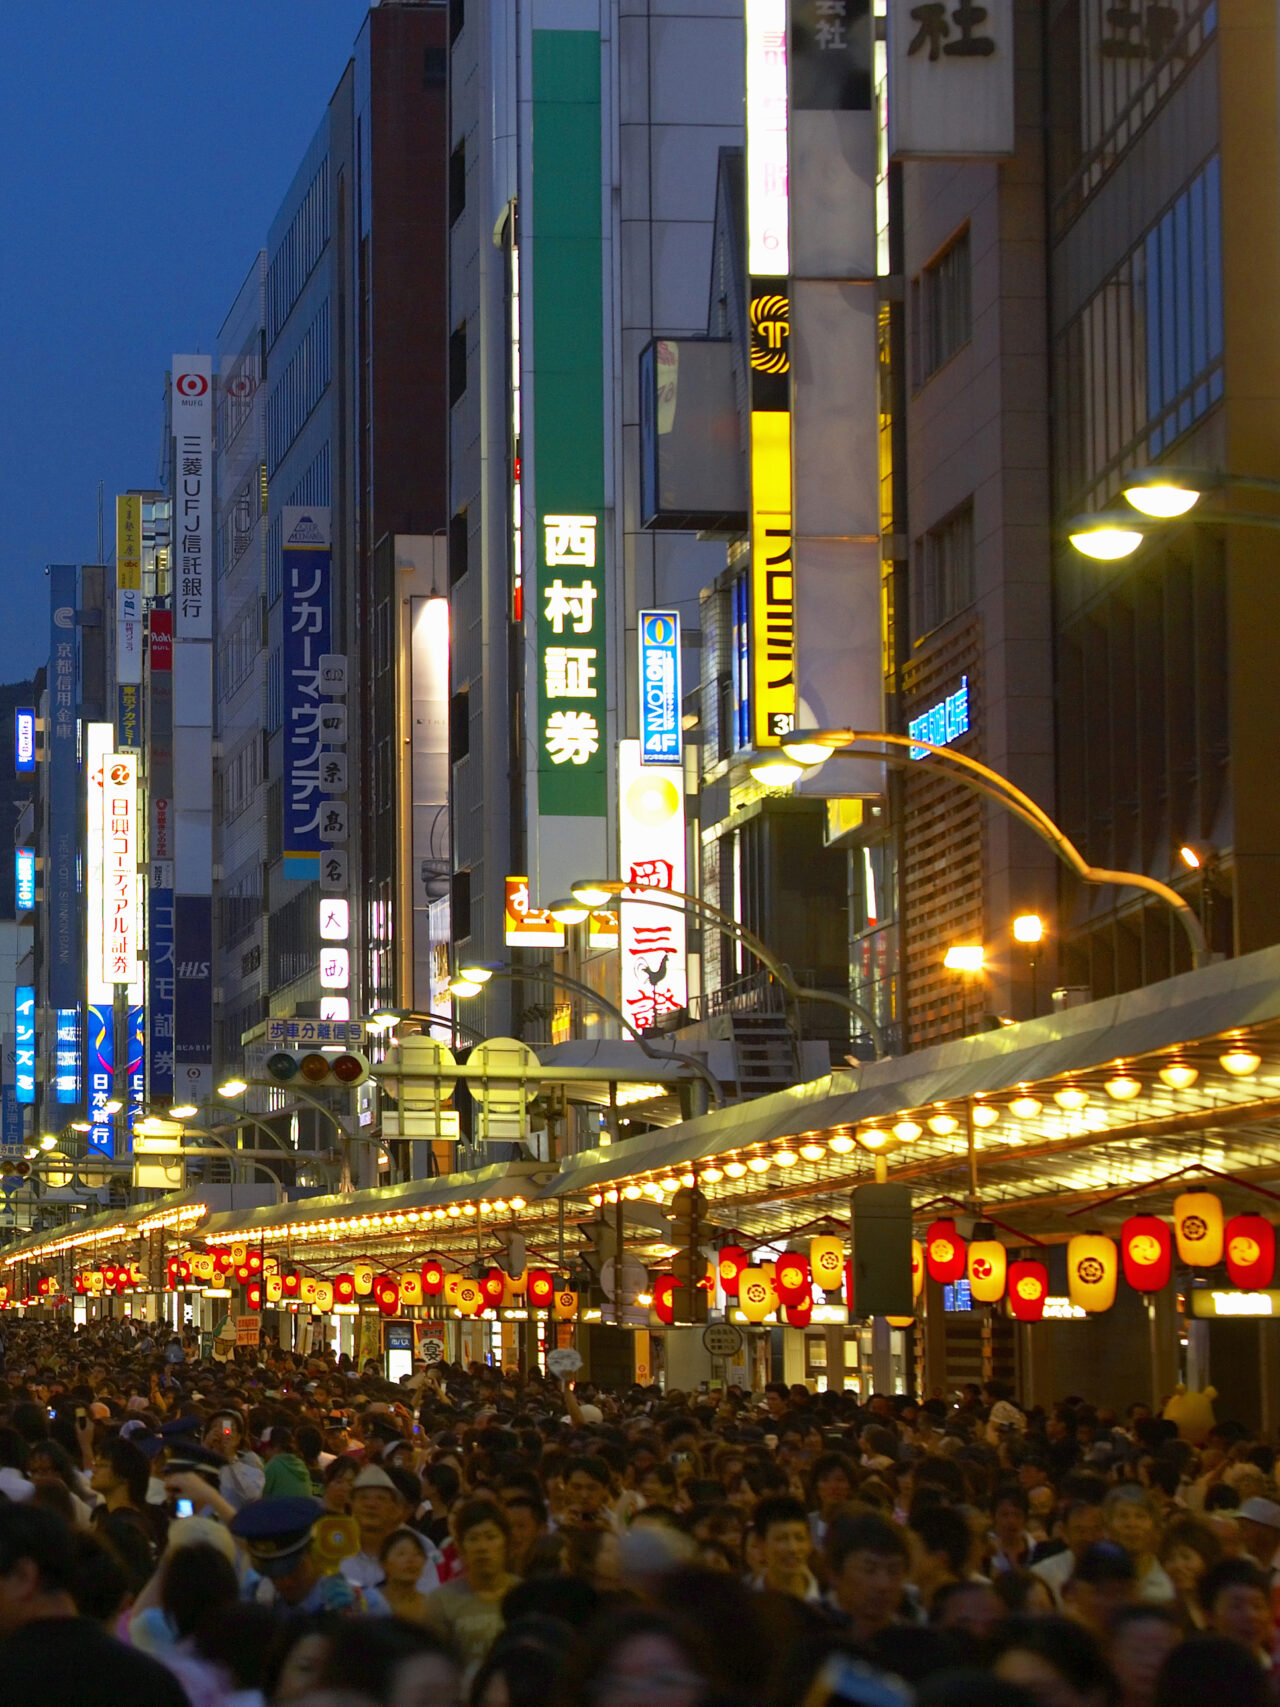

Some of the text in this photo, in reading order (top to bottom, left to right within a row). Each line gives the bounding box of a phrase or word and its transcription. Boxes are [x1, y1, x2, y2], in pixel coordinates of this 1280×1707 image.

[182, 435, 203, 618] 三菱UFJ信託銀行
[124, 591, 135, 619] TBC
[543, 514, 600, 765] 西村証券
[56, 641, 73, 740] 京都信用金庫
[291, 568, 322, 834] リカーマウンテン
[646, 734, 677, 753] 4F
[111, 799, 130, 974] 日興コーディアル証券
[153, 906, 174, 1075] コスモ証券
[269, 1023, 363, 1041] 歩車分離信号
[92, 1073, 110, 1145] 日本旅行
